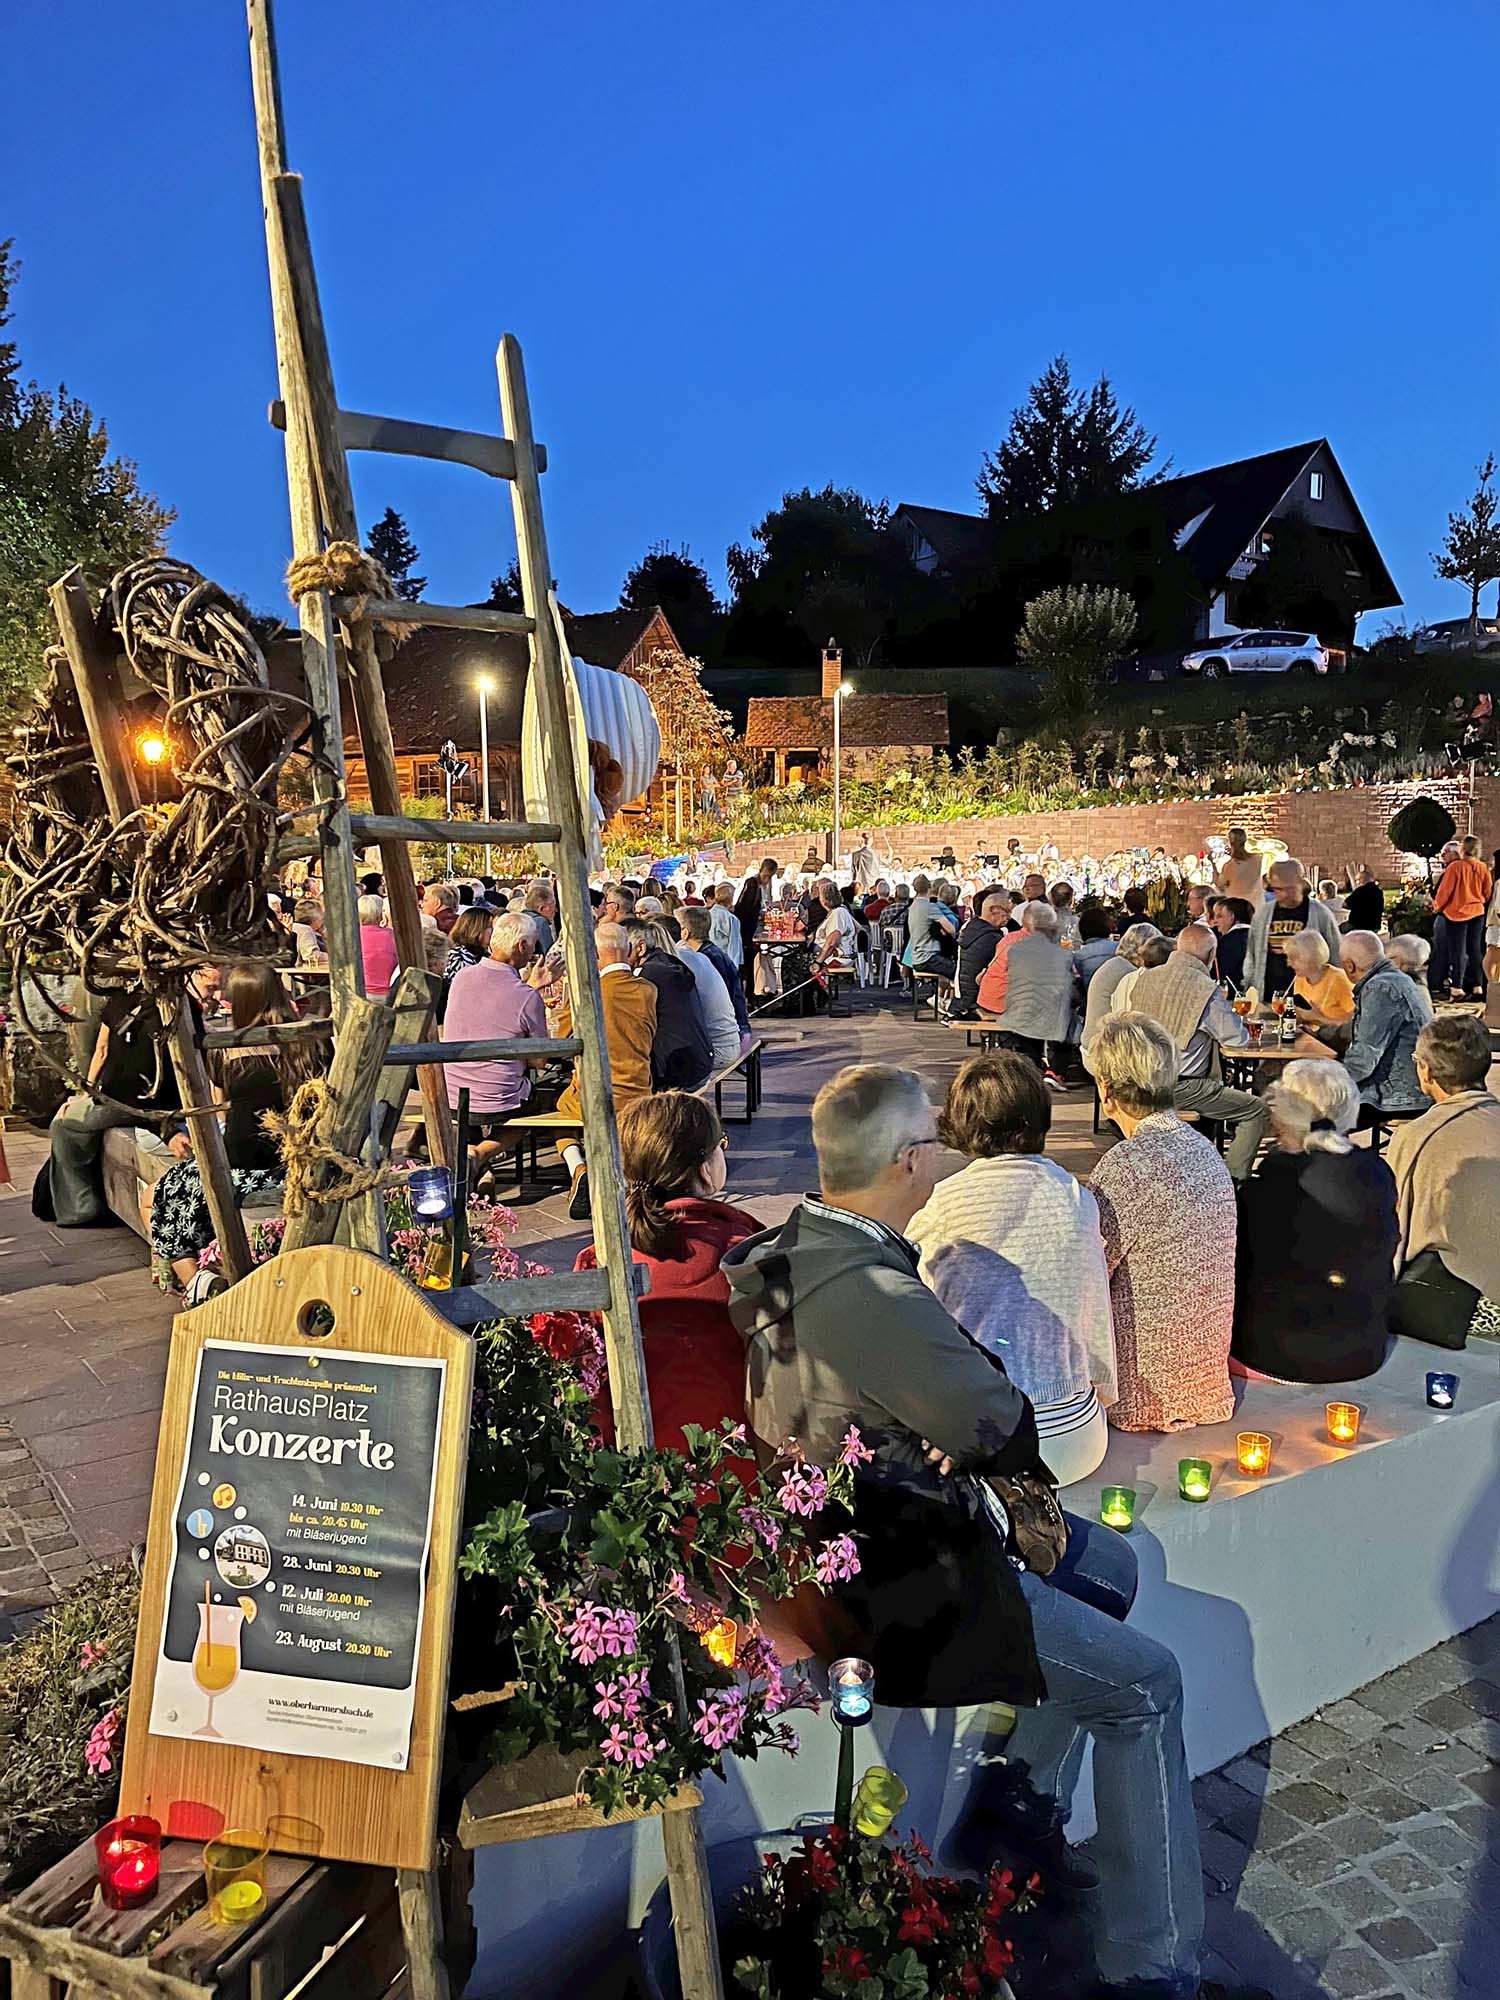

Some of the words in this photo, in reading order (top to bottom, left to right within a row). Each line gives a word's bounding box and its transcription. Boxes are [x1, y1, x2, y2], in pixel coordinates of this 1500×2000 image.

[256, 1375, 271, 1383] und
[214, 1385, 369, 1422] RathausPlatz
[209, 1415, 395, 1471] Konzerte
[292, 1494, 306, 1507] 14.
[310, 1496, 338, 1511] Juni
[340, 1502, 363, 1514] 19.30
[366, 1504, 384, 1516] Uhr
[289, 1512, 303, 1523] bis
[306, 1516, 319, 1525] ca.
[322, 1515, 348, 1528] 20.45
[350, 1518, 368, 1530] Uhr
[286, 1527, 301, 1538] mit
[303, 1528, 368, 1545] Bläserjugend
[282, 1555, 301, 1568] 28.
[304, 1558, 332, 1573] Juni
[335, 1563, 361, 1576] 20.30
[363, 1567, 382, 1578] Uhr
[281, 1584, 297, 1598] 12.
[300, 1586, 324, 1601] Juli
[326, 1591, 352, 1604] 20.00
[354, 1595, 373, 1607] Uhr
[279, 1602, 294, 1613] mit
[296, 1603, 361, 1621] Bläserjugend
[275, 1630, 294, 1645] 23.
[297, 1633, 342, 1653] August
[345, 1642, 371, 1655] 20.30
[374, 1645, 392, 1658] Uhr
[268, 1698, 374, 1719] www.oberharmersbach.de
